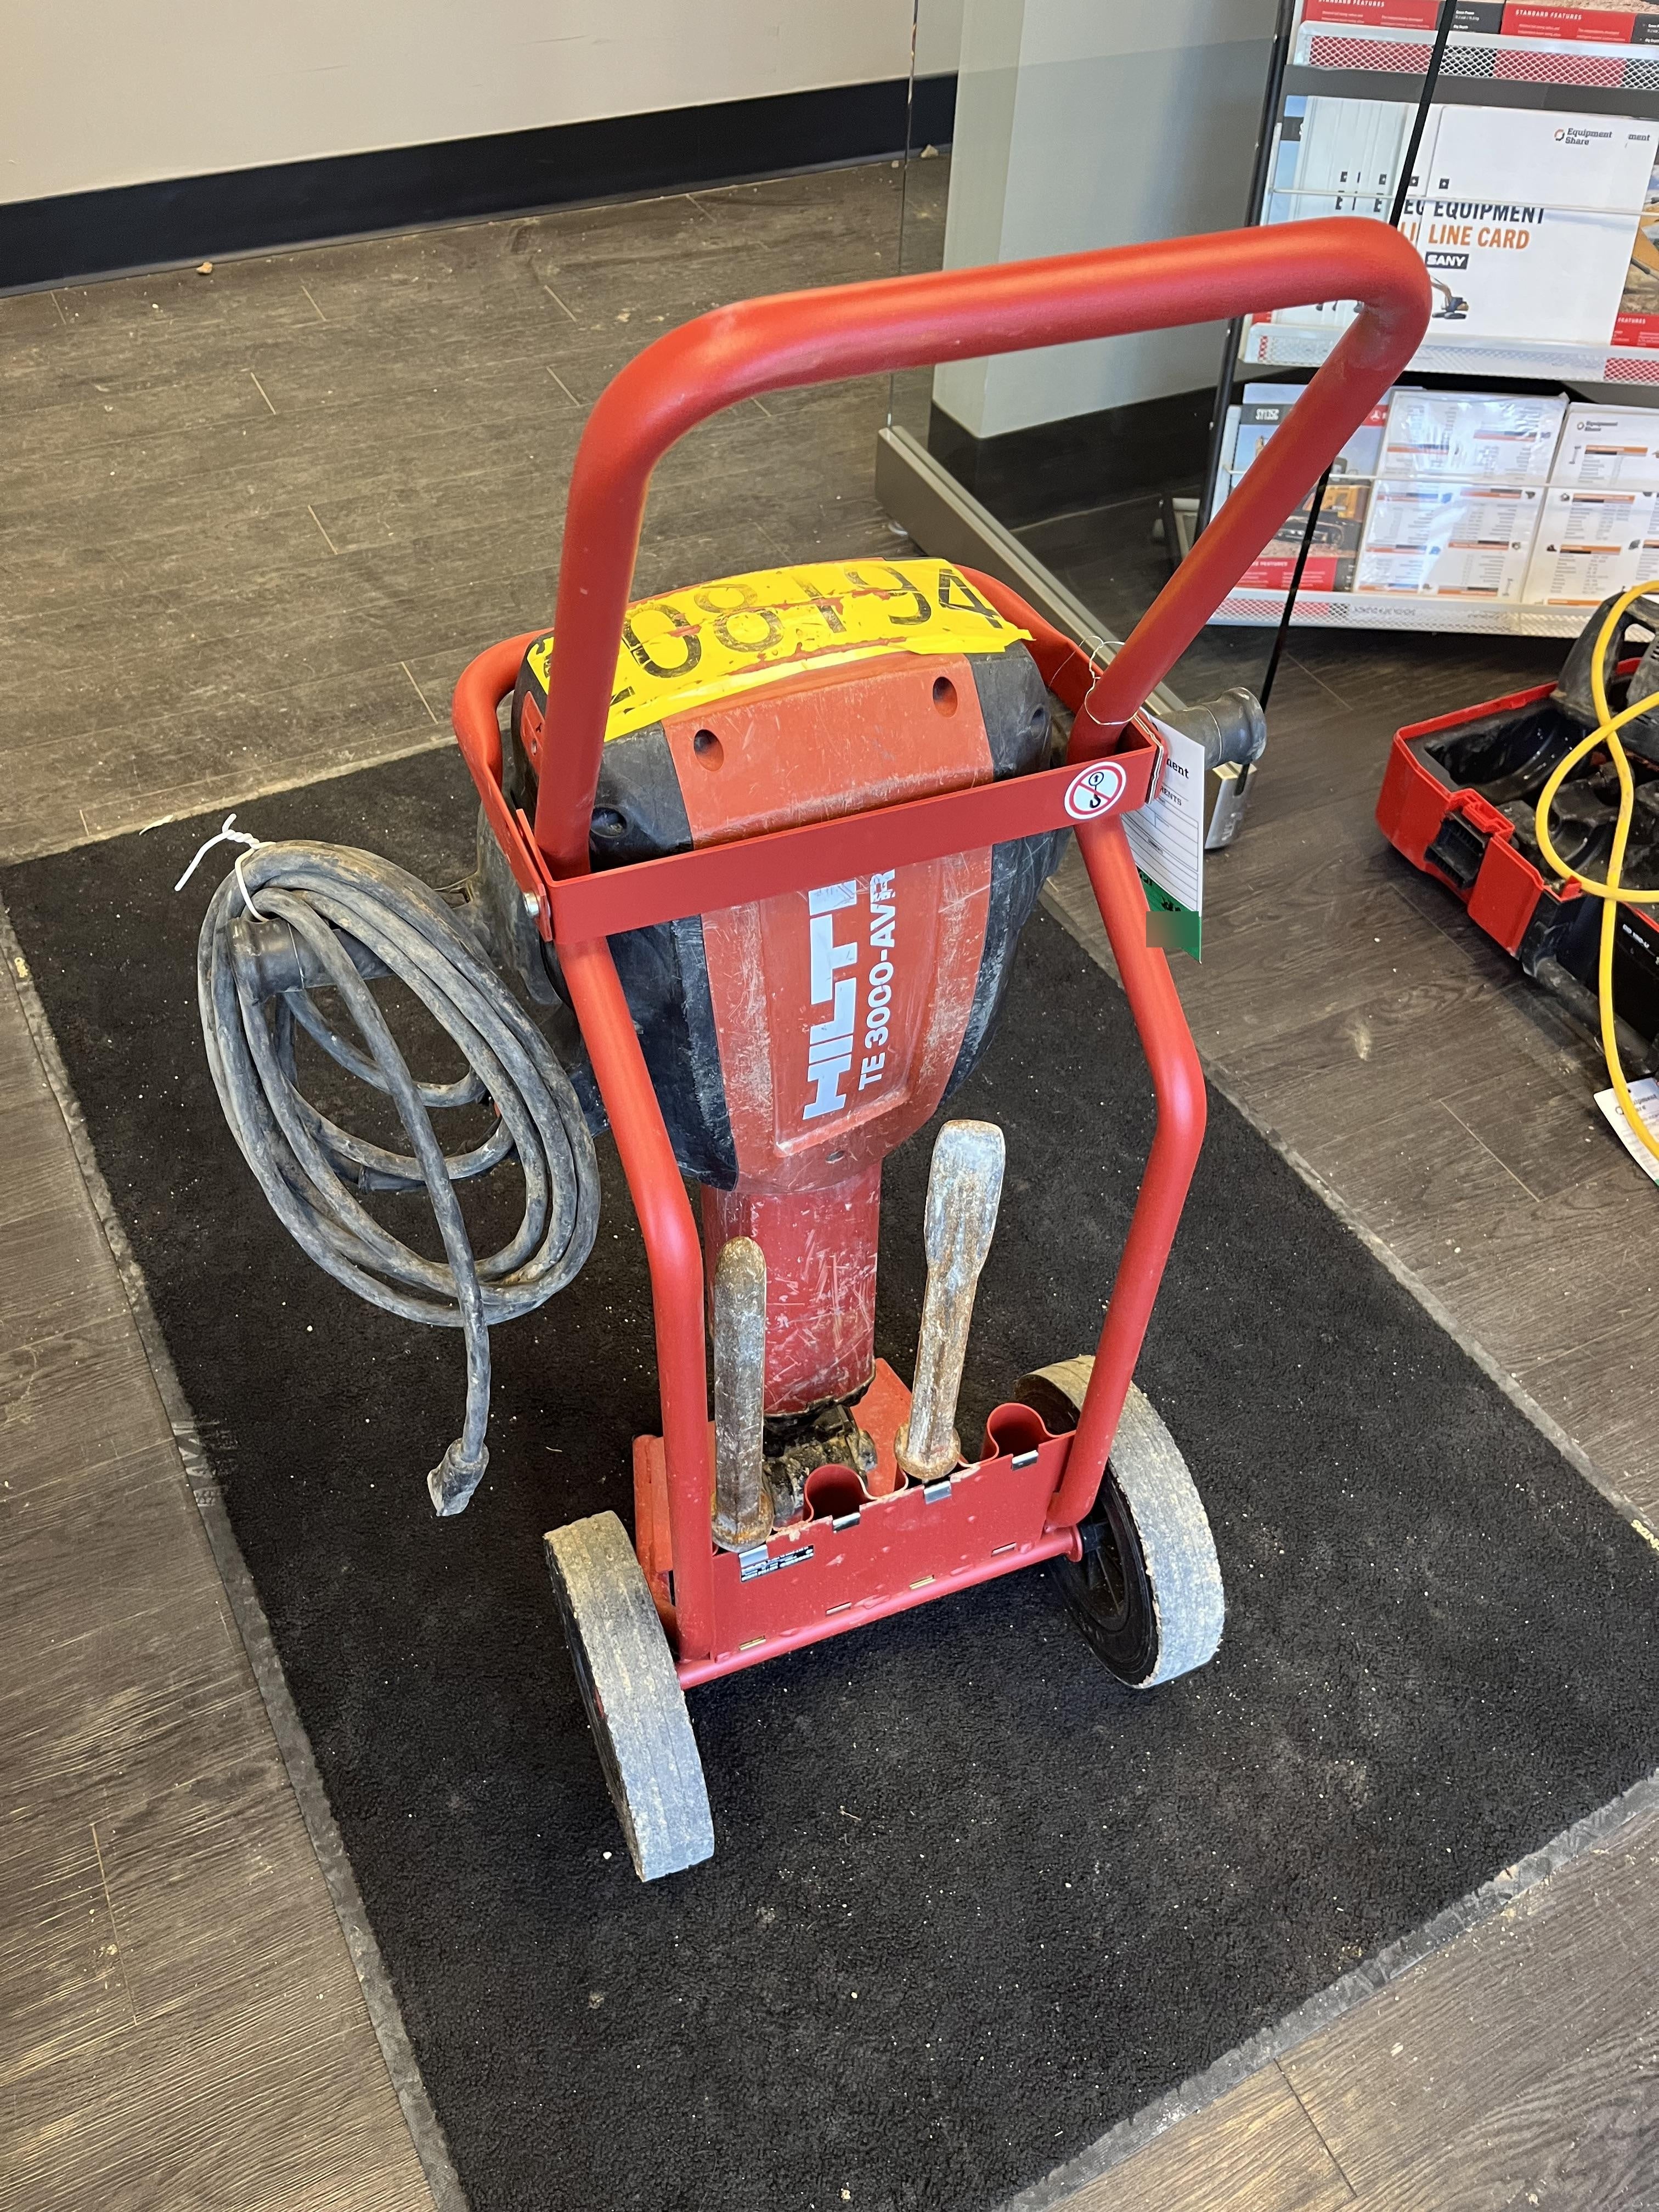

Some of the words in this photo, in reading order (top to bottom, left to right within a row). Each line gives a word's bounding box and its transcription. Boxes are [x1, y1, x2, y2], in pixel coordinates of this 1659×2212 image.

[1565, 137, 1590, 145] Share
[1567, 128, 1612, 138] Equipment
[1428, 224, 1473, 246] LINE
[1477, 227, 1530, 250] CARD
[1426, 254, 1466, 267] SANY
[543, 565, 1005, 708] 08194
[865, 868, 896, 1049] 3000-AVR
[802, 879, 858, 1120] HILTI
[858, 1052, 885, 1091] TE
